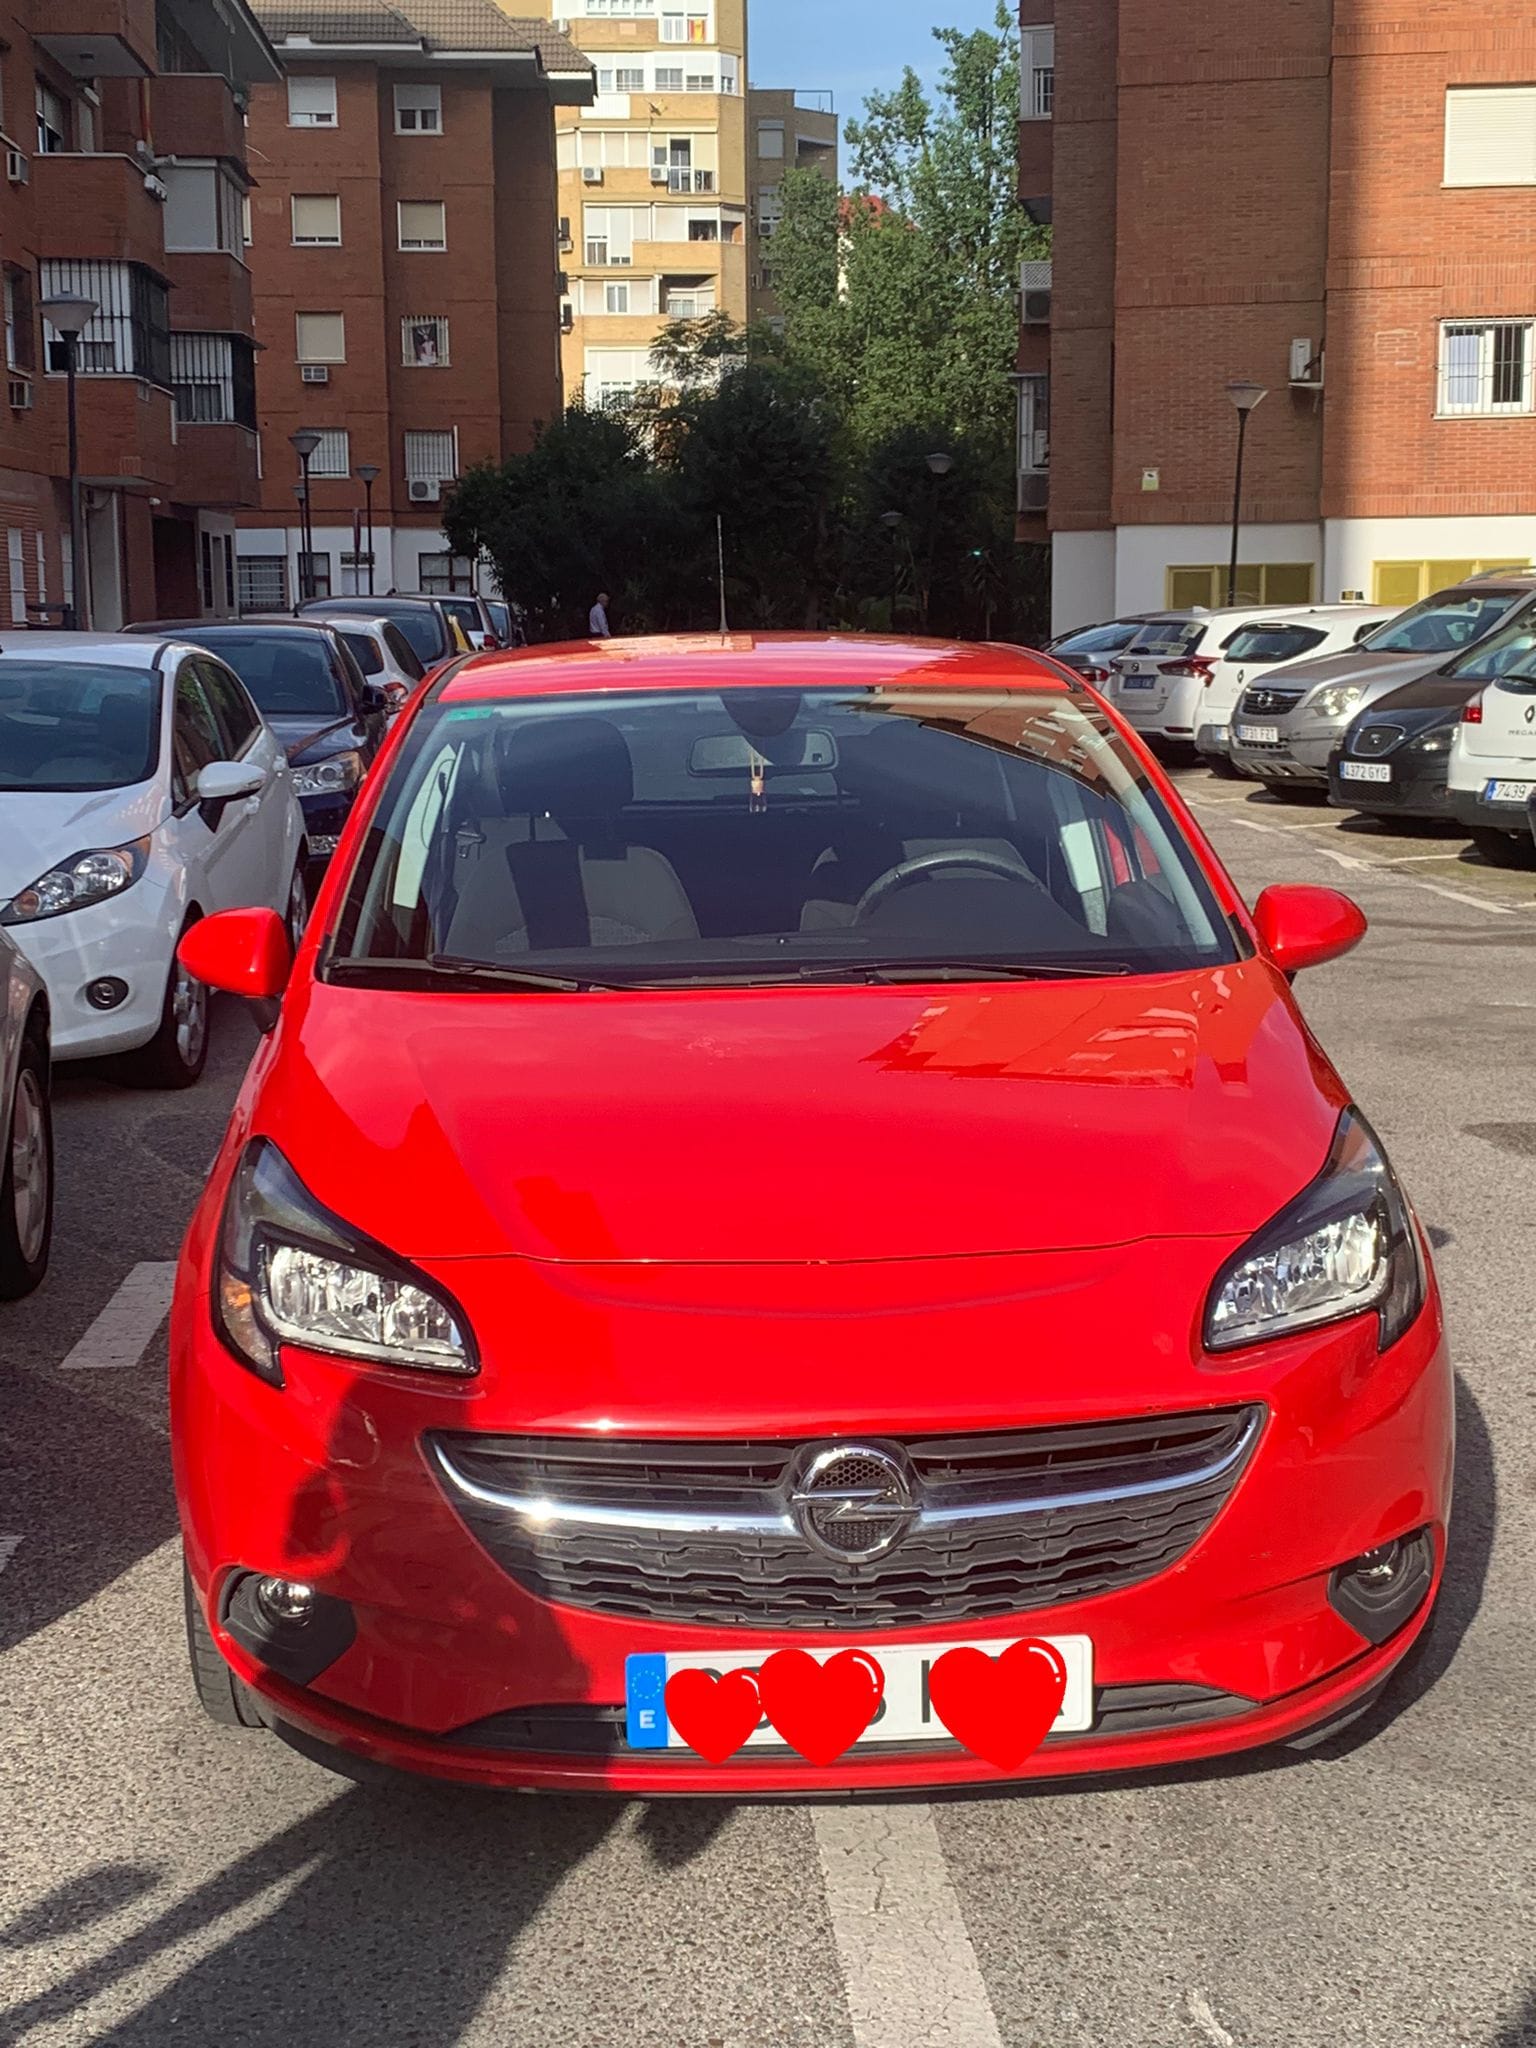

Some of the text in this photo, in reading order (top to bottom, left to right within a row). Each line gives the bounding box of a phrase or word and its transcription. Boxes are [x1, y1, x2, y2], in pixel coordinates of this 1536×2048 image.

[1345, 764, 1366, 778] 4372
[1496, 783, 1527, 799] 7439
[639, 1709, 656, 1729] E
